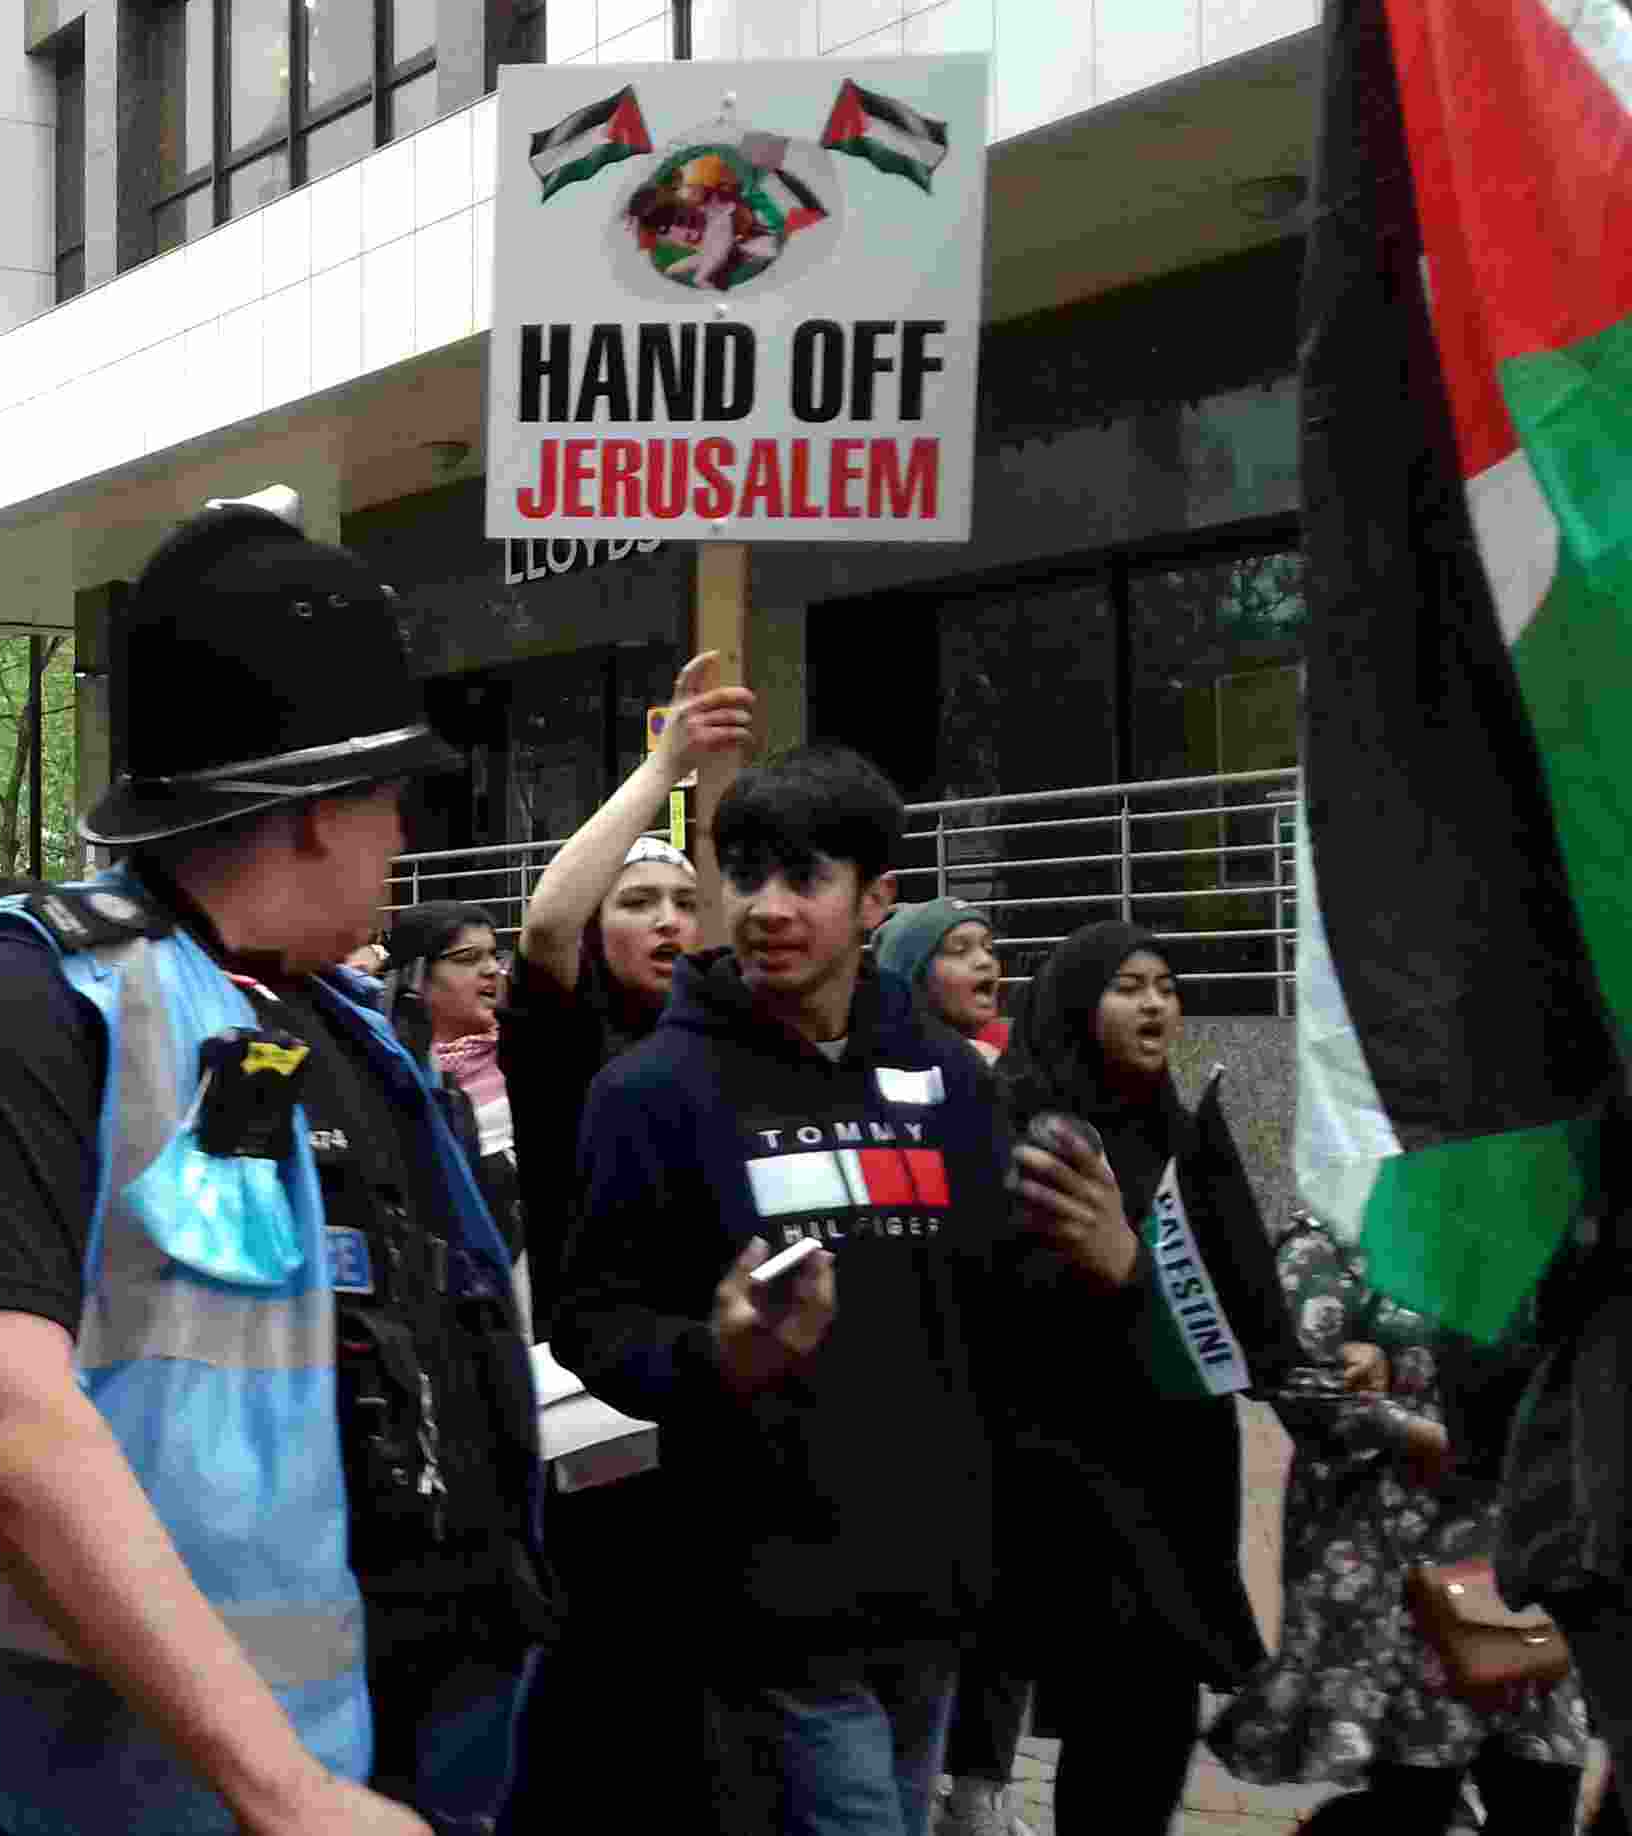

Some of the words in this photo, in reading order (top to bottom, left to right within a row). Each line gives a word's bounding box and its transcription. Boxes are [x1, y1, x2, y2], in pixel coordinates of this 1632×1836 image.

[519, 321, 756, 423] HAND
[791, 319, 946, 422] OFF
[516, 436, 940, 520] JERUSALEM
[504, 537, 662, 585] LLOY
[755, 1121, 923, 1149] TOMMY
